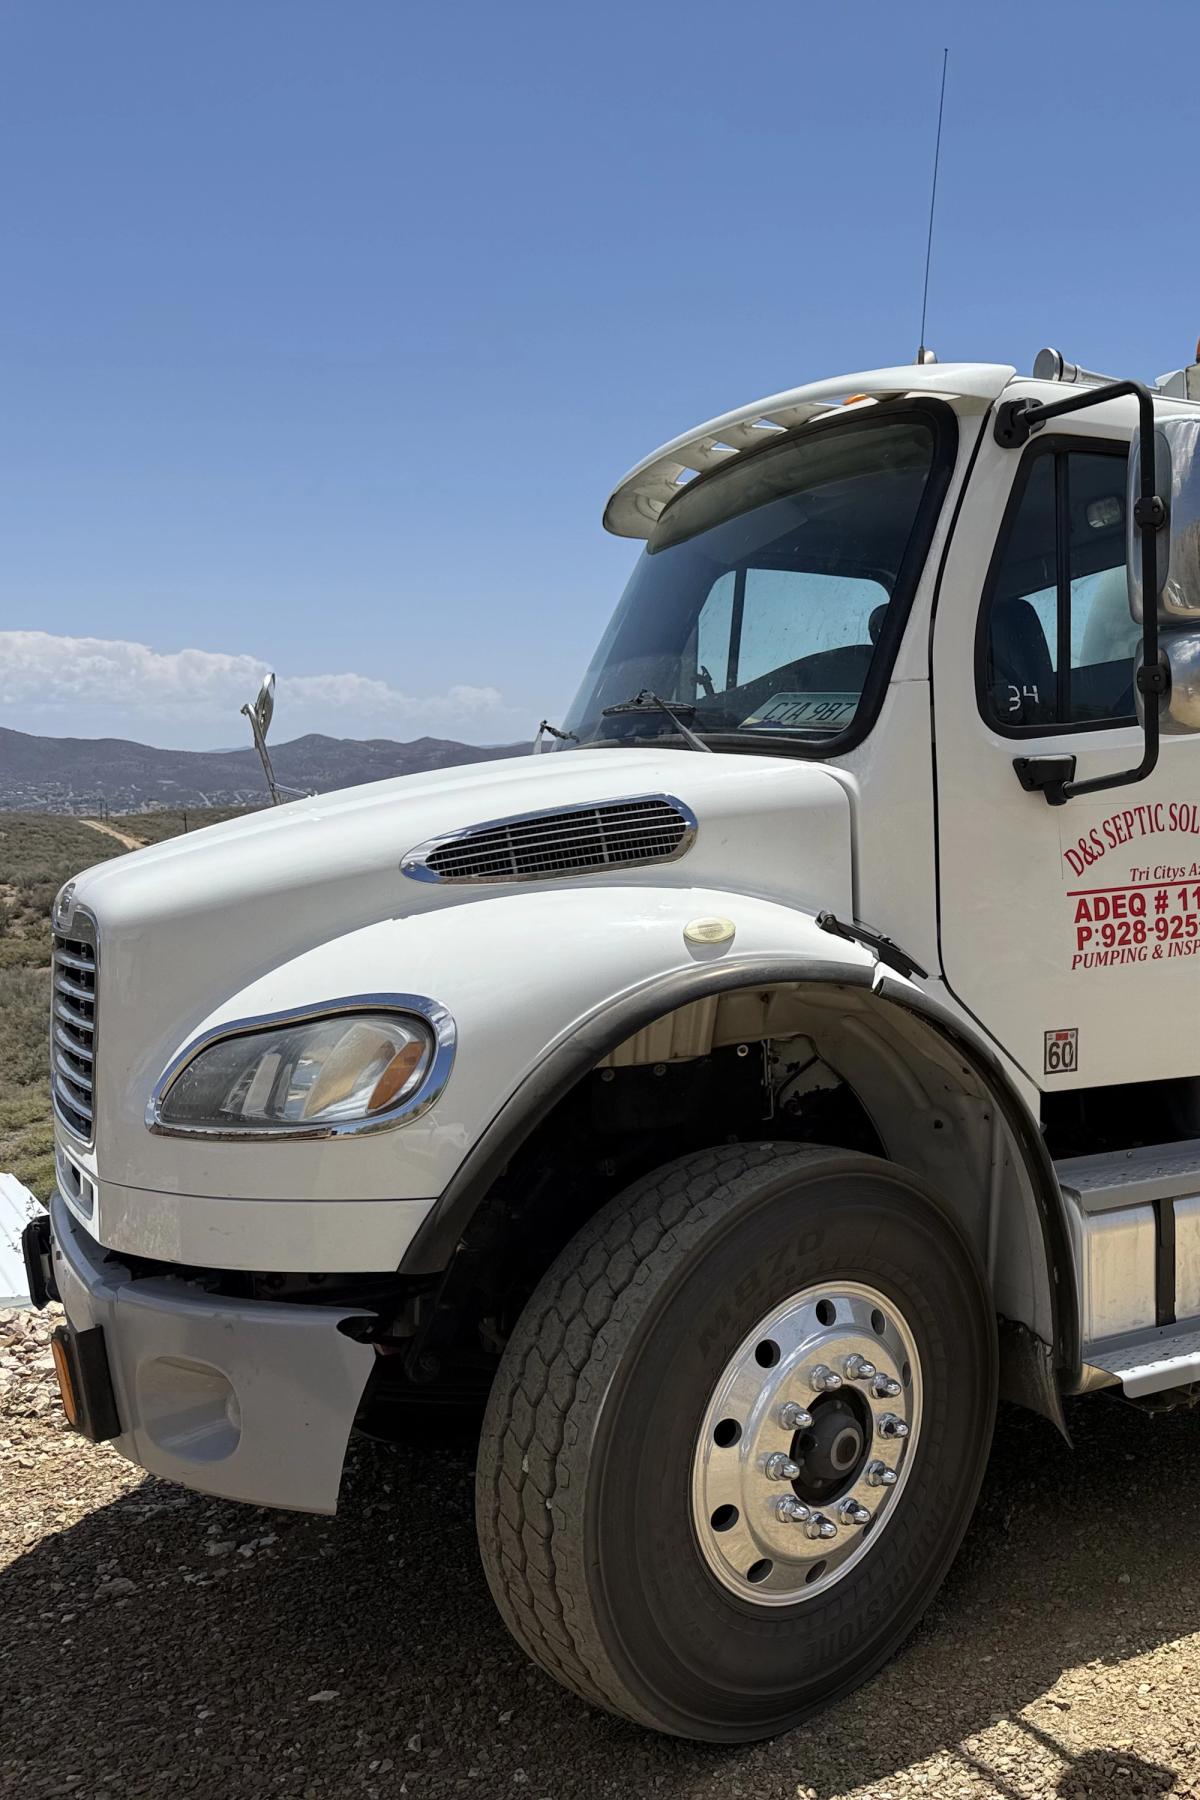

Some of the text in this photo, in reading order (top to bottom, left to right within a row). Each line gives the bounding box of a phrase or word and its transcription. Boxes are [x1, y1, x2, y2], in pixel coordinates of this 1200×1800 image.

[1007, 685, 1039, 711] 34
[1064, 828, 1105, 878] D&S
[1102, 803, 1165, 849] SEPTIC
[1129, 867, 1151, 882] Tri
[1153, 865, 1186, 883] Citys
[1074, 893, 1147, 923] ADEQ
[1154, 890, 1169, 914] #
[1071, 946, 1148, 971] PUMPING
[1152, 944, 1164, 959] &
[1048, 1041, 1074, 1069] 60
